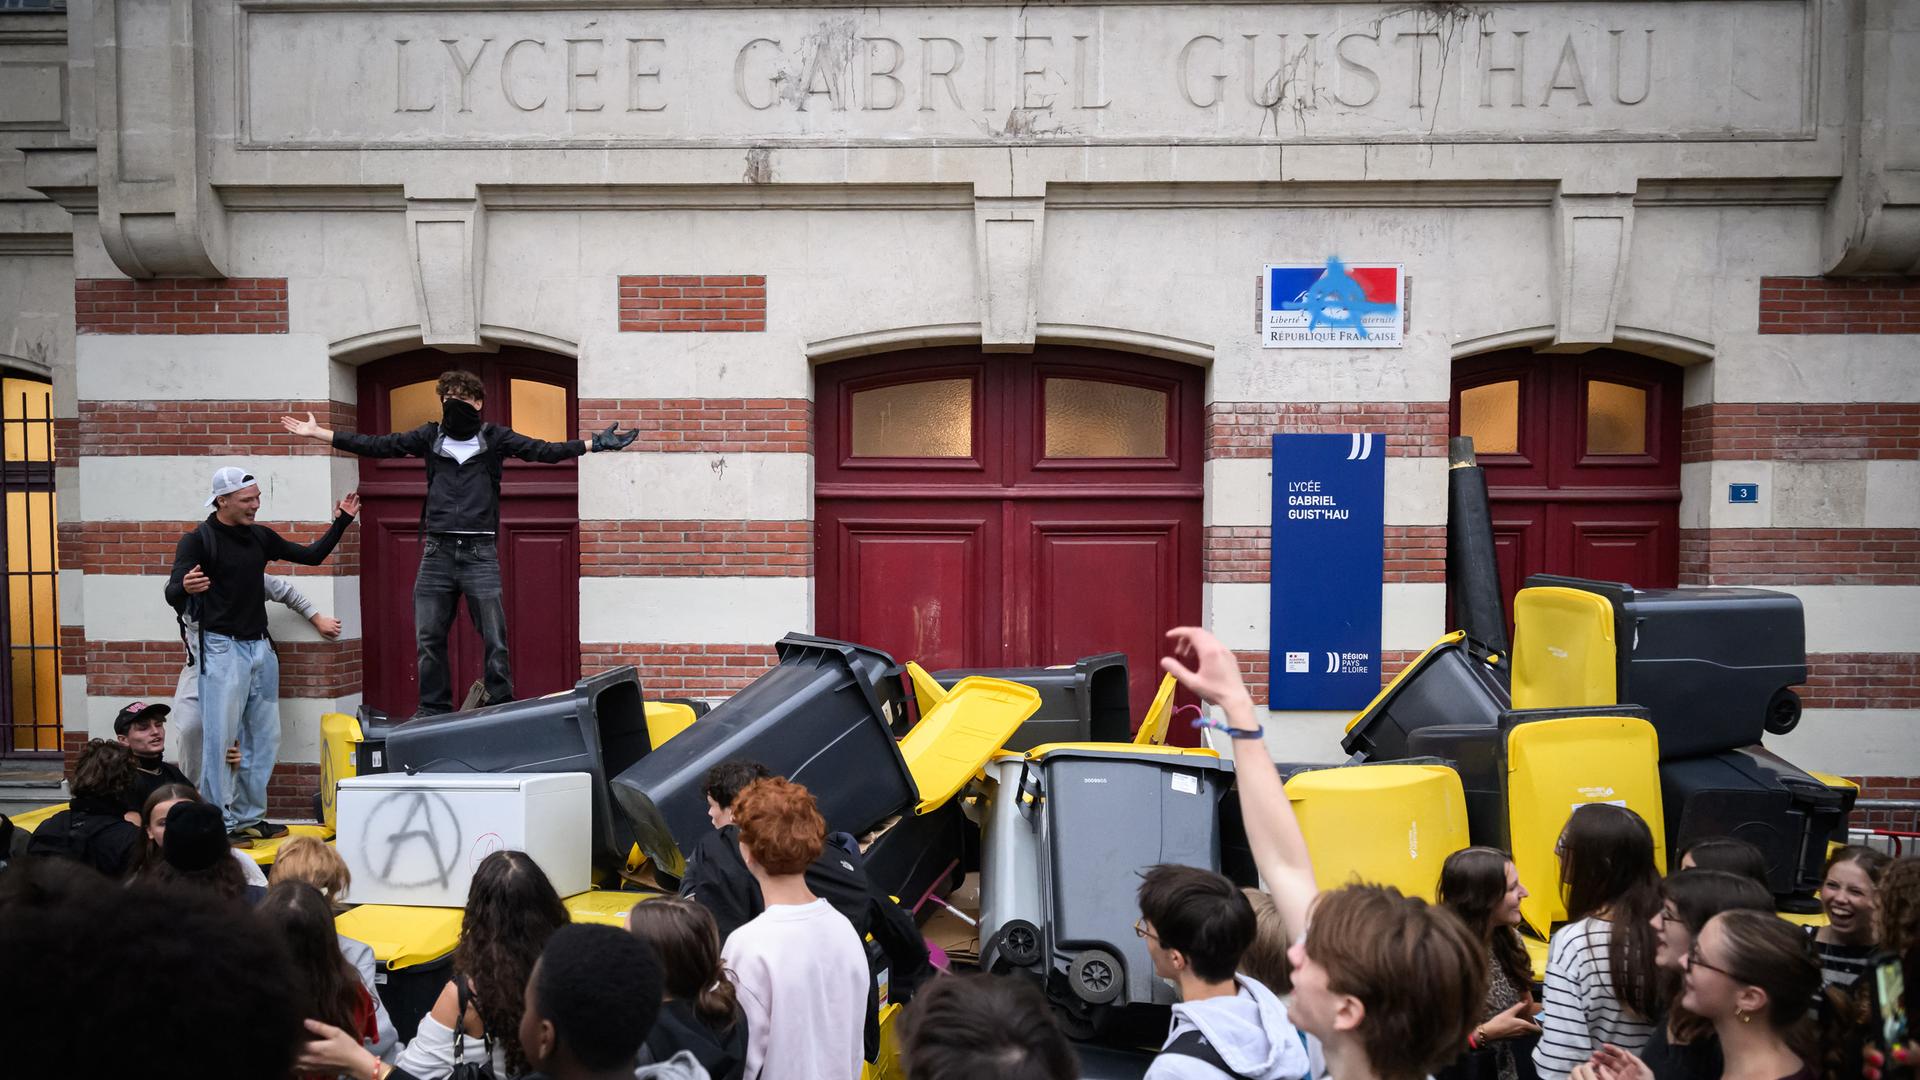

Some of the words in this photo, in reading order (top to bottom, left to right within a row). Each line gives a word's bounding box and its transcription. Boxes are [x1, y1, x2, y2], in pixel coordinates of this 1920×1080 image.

[733, 36, 1113, 112] GABRIEL
[1270, 331, 1336, 342] RÉPUBLIQUE
[1288, 480, 1321, 492] LYCÉE
[1740, 488, 1747, 498] 3
[1288, 496, 1337, 506] GABRIEL
[1288, 510, 1349, 520] GUIST'HAU
[1342, 652, 1369, 660] RÉGION
